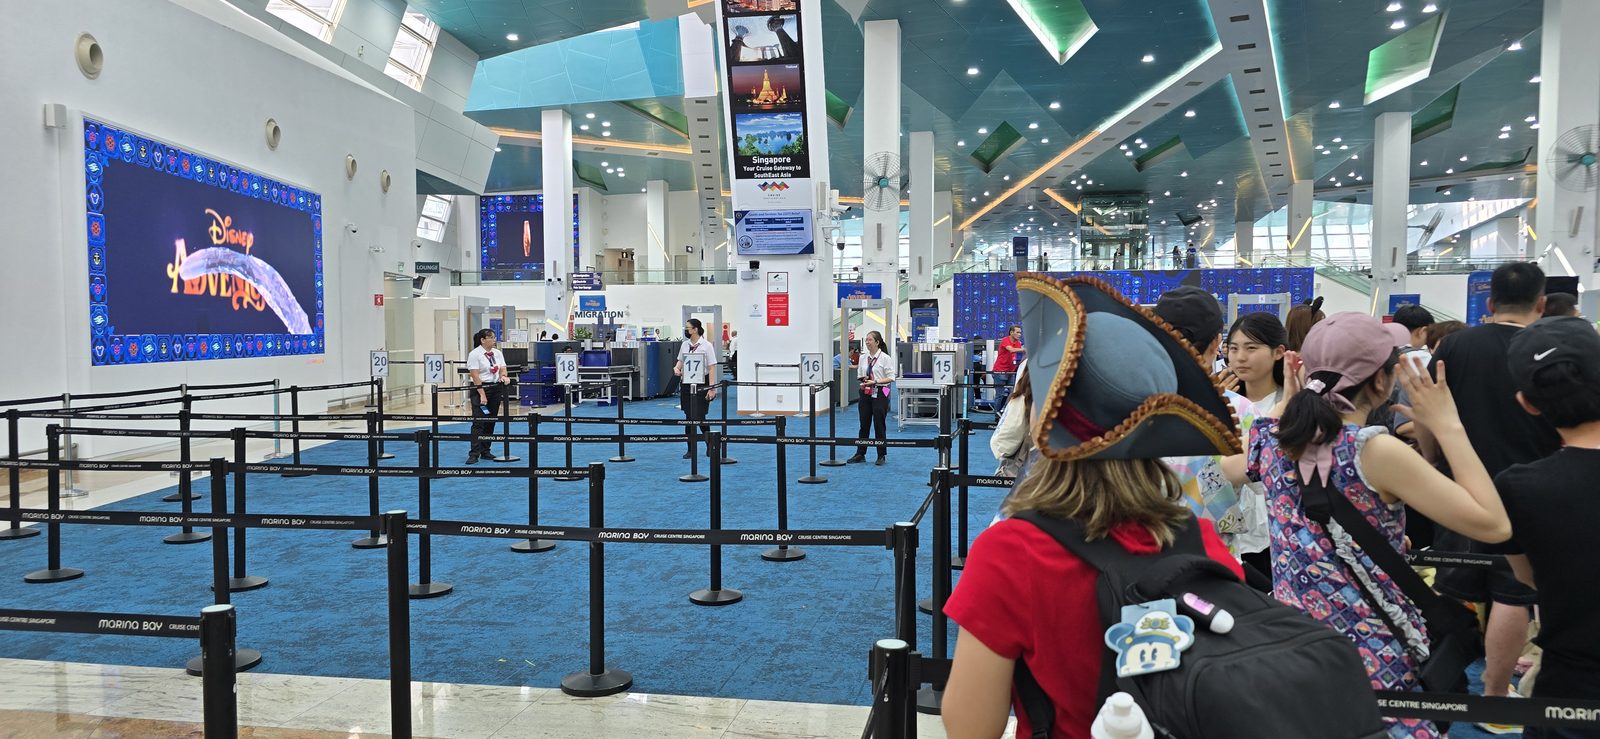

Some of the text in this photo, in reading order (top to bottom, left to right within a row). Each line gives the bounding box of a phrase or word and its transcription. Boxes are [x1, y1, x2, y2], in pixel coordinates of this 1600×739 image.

[752, 156, 791, 165] Singapore
[204, 208, 254, 255] Disney
[374, 356, 387, 366] 20
[428, 360, 442, 371] 19
[560, 360, 575, 372] 18
[686, 360, 700, 371] 17
[804, 360, 820, 371] 16
[935, 360, 950, 371] 15
[98, 619, 139, 629] MARINA
[142, 621, 163, 631] BAY
[1388, 700, 1420, 709] CENTRE
[1421, 701, 1468, 712] SINGAPORE
[1545, 706, 1600, 721] MARIN
